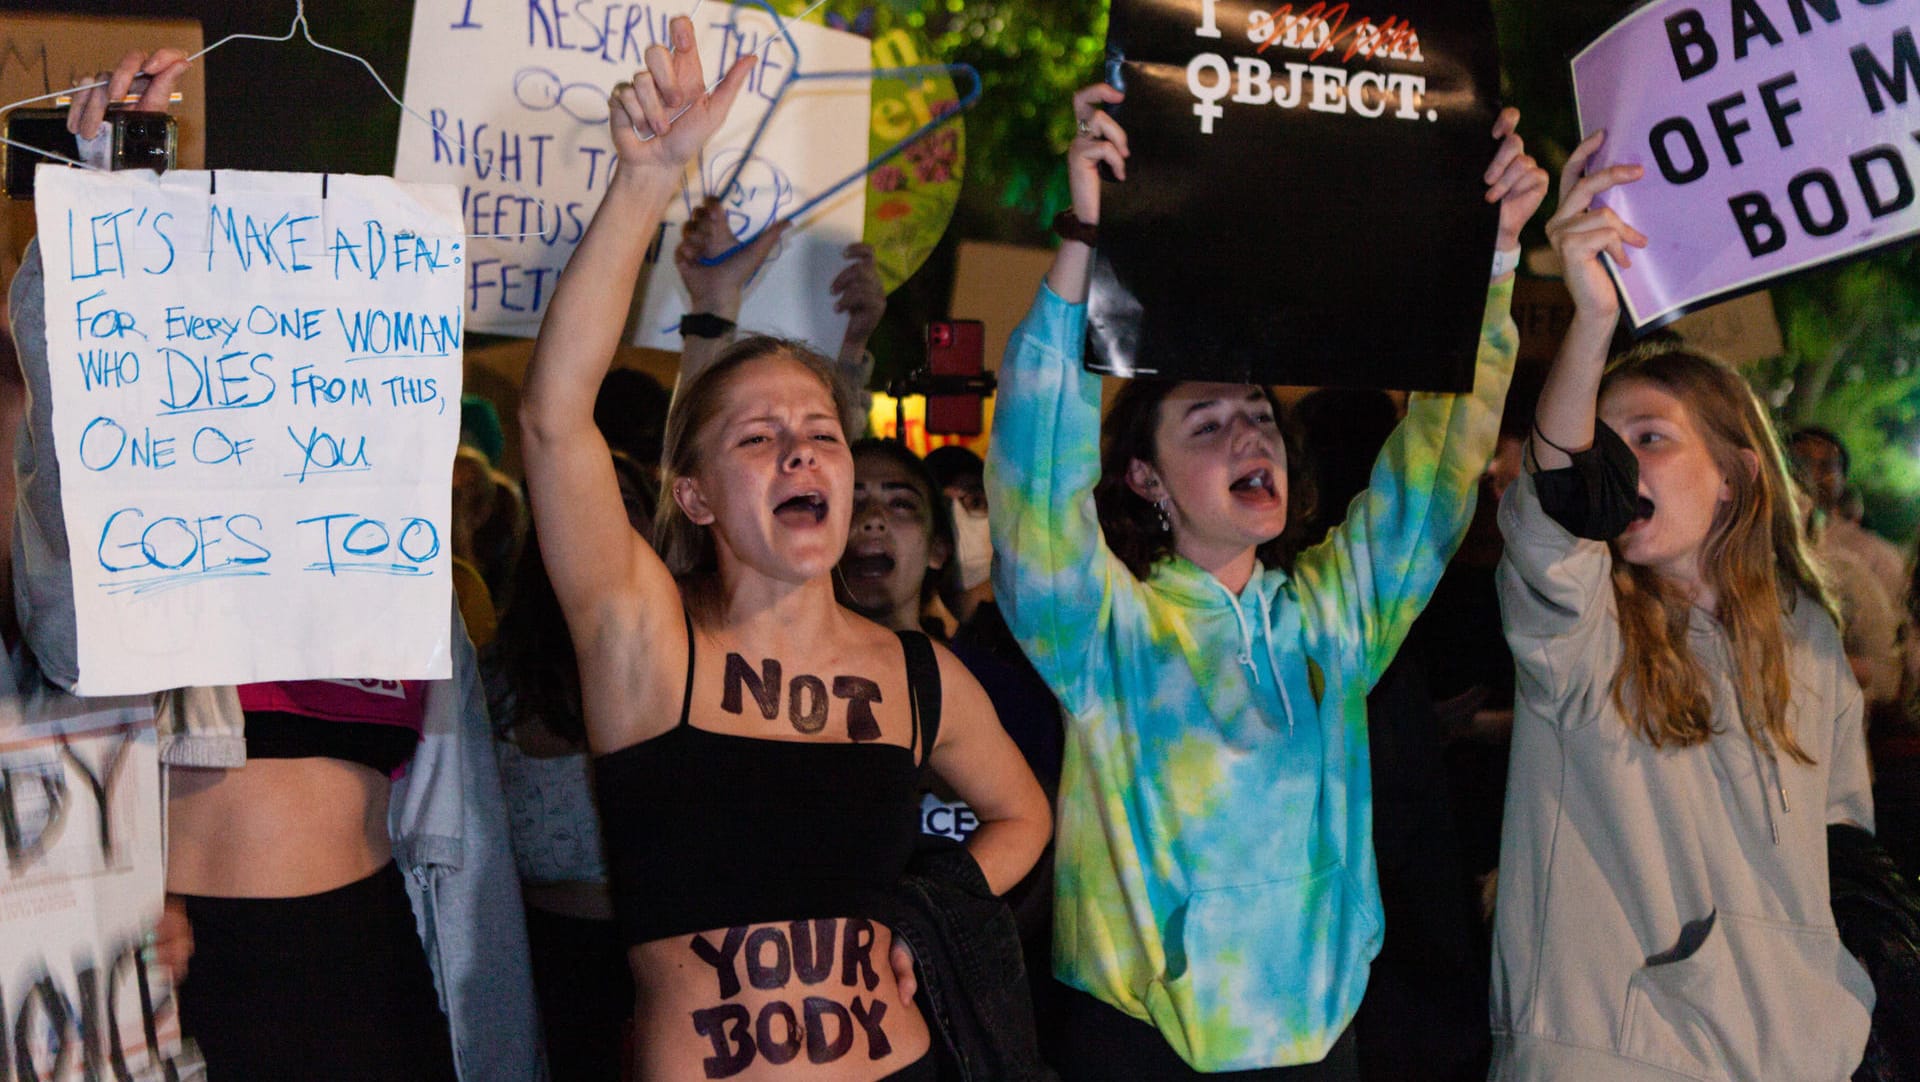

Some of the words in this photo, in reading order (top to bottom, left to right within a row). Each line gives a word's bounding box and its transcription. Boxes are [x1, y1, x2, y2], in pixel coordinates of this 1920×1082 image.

[529, 0, 674, 64] RESERV
[1195, 0, 1222, 39] I
[1247, 9, 1335, 52] am
[1186, 52, 1438, 134] OBJECT.
[1648, 71, 1802, 185] OFF
[430, 108, 554, 188] RIGHT
[579, 146, 617, 191] T
[1728, 130, 1920, 258] BOD
[69, 207, 175, 281] LET'S
[208, 205, 321, 273] MAKE
[328, 222, 363, 280] A
[364, 220, 462, 281] DEAL:
[76, 289, 147, 342] FOR
[247, 305, 327, 339] ONE
[337, 304, 461, 356] WOMAN
[469, 258, 562, 312] FET
[78, 349, 140, 391] WHO
[157, 347, 276, 408] DIES
[292, 365, 372, 407] FROM
[382, 375, 447, 415] THIS,
[79, 416, 176, 472] ONE
[192, 426, 255, 466] OF
[287, 425, 372, 483] YOU
[98, 508, 272, 573] GOES
[296, 513, 441, 577] TOO
[720, 652, 883, 741] NOT
[689, 918, 880, 1000] YOUR
[692, 995, 892, 1080] BODY
